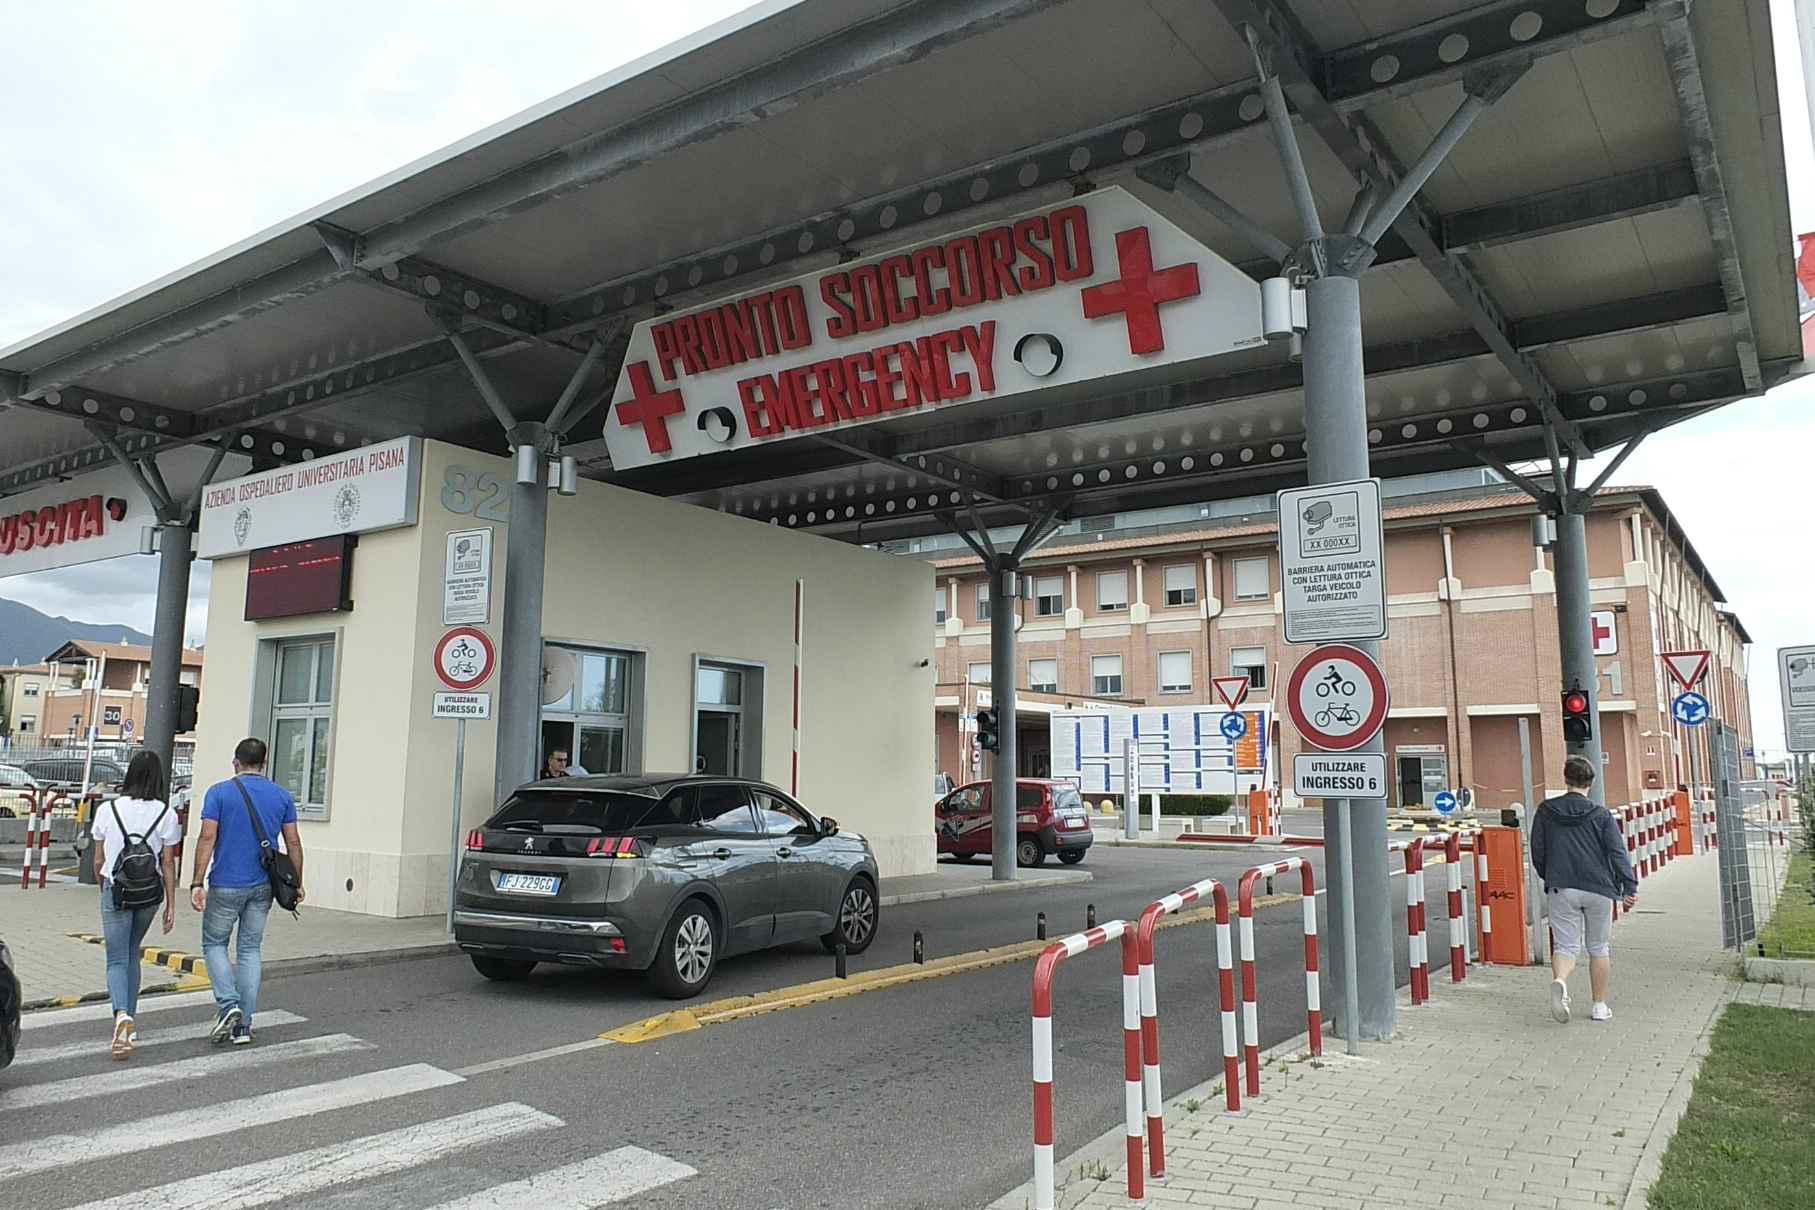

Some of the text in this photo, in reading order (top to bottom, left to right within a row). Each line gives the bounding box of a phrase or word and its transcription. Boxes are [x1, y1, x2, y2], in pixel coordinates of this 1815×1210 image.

[651, 205, 1094, 381] PRONTO SOCCORSO
[737, 320, 996, 438] EMERGENCY
[205, 447, 405, 508] AZIENDA OSPEDALIERO UNIVERSITARIA PISANA
[441, 464, 512, 523] 82
[0, 495, 104, 555] USCITA
[1288, 560, 1376, 575] BARRIERA AUTOMATICA
[1292, 570, 1372, 585] CON LETTURA OTTICA
[1303, 581, 1361, 593] TARGA VEICOLO
[1307, 591, 1358, 602] AUTORIZZATO
[105, 711, 120, 720] 30
[437, 704, 477, 714] INGRESSO
[1311, 762, 1366, 772] UTILIZZARE
[1302, 776, 1377, 790] INGRESSO 6
